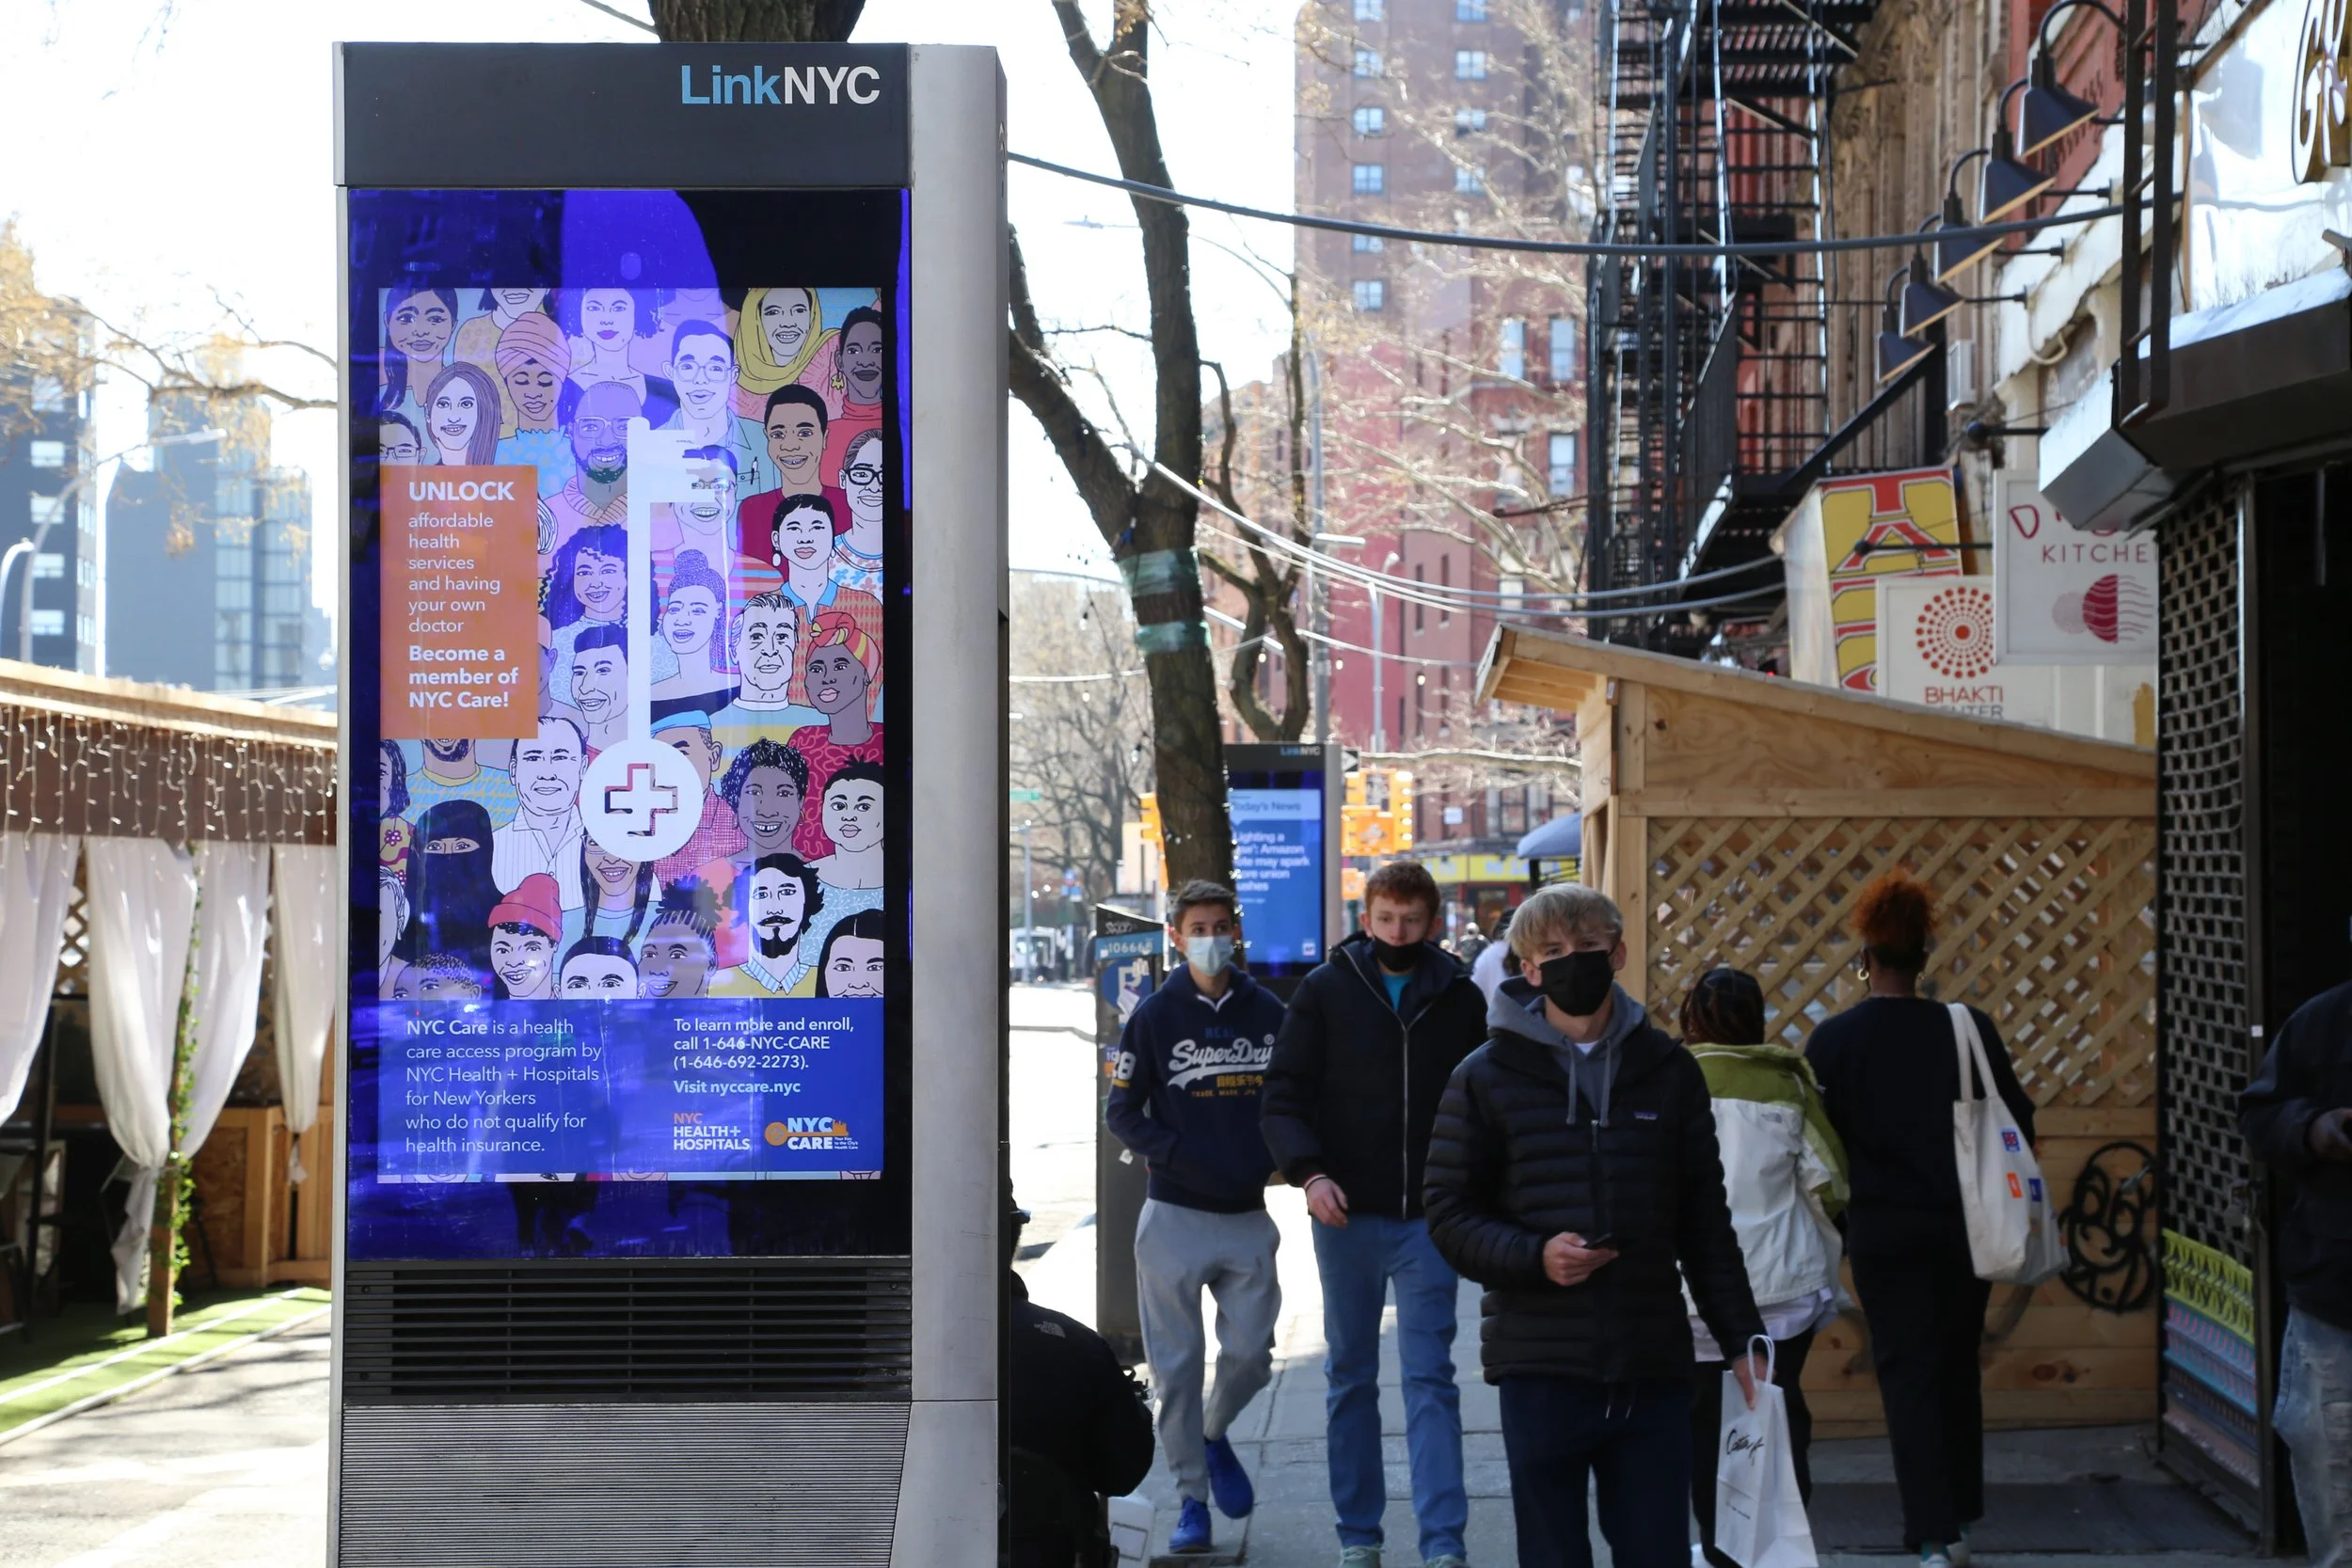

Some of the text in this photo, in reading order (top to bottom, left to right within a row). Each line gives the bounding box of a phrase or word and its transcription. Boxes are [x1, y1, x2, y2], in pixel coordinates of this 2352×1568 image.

[682, 64, 881, 105] LinkNYC
[408, 481, 515, 501] UNLOCK
[408, 513, 494, 529] affordable
[408, 533, 460, 549] health
[408, 555, 475, 570] services
[408, 576, 501, 594] and having
[408, 600, 485, 617] your own
[408, 618, 465, 633] doctor
[408, 645, 505, 662] Become a
[408, 667, 519, 685] member of
[408, 690, 509, 708] NYC Care!
[1924, 684, 2003, 705] BHAKTI
[1271, 801, 1302, 812] News
[1254, 857, 1279, 869] may
[406, 1018, 574, 1036] NYC Care is a health
[674, 1017, 854, 1033] To learn more and enroll,
[674, 1036, 830, 1051] call 1-646-NYC-CARE
[406, 1042, 602, 1062] care access program by
[674, 1054, 809, 1070] (1-646-692-2273).
[406, 1067, 444, 1083] NYC
[449, 1067, 502, 1082] Health
[523, 1066, 599, 1085] Hospitals
[674, 1081, 801, 1097] Visit nyccare.nyc
[406, 1089, 536, 1106] for New Yorkers
[405, 1112, 587, 1132] who do not qualify for
[674, 1113, 703, 1124] NYC
[787, 1117, 833, 1132] NYC
[406, 1137, 546, 1153] health insurance.
[674, 1138, 751, 1151] HOSPITALS
[787, 1136, 834, 1150] CARE
